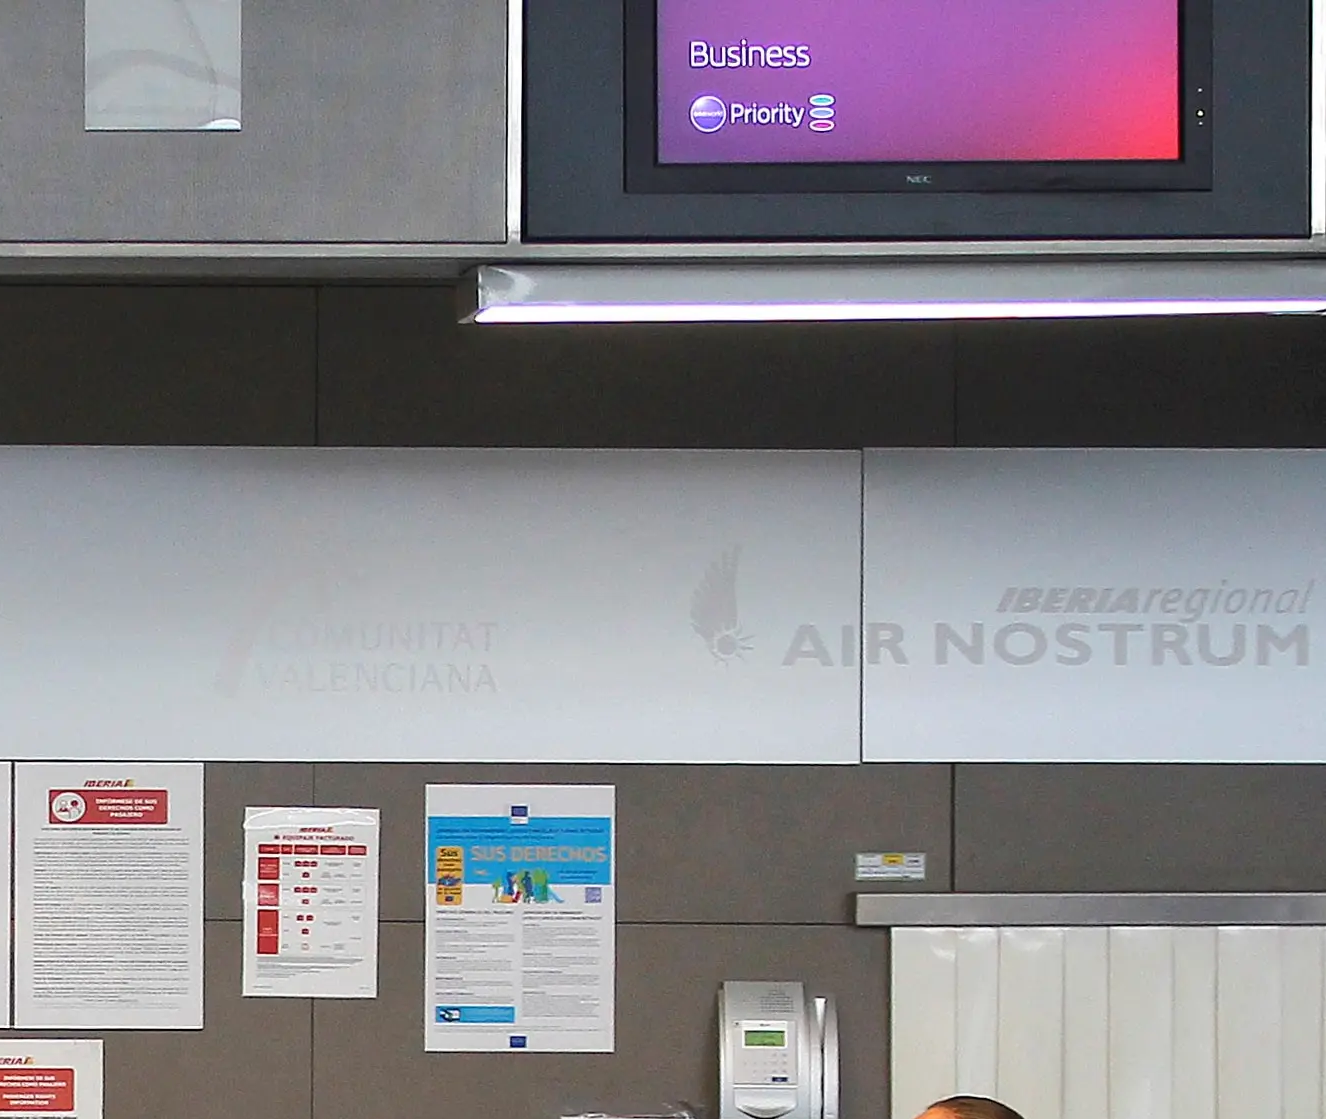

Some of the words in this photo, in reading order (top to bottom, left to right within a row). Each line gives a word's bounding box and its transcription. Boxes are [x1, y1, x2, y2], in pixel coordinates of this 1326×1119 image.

[689, 39, 811, 68] Business
[730, 102, 805, 128] Priority
[906, 175, 931, 184] NEC
[781, 622, 909, 667] AIR
[934, 621, 1310, 668] NOSTRUM
[471, 845, 507, 862] SUS
[511, 846, 607, 862] DERECHOS
